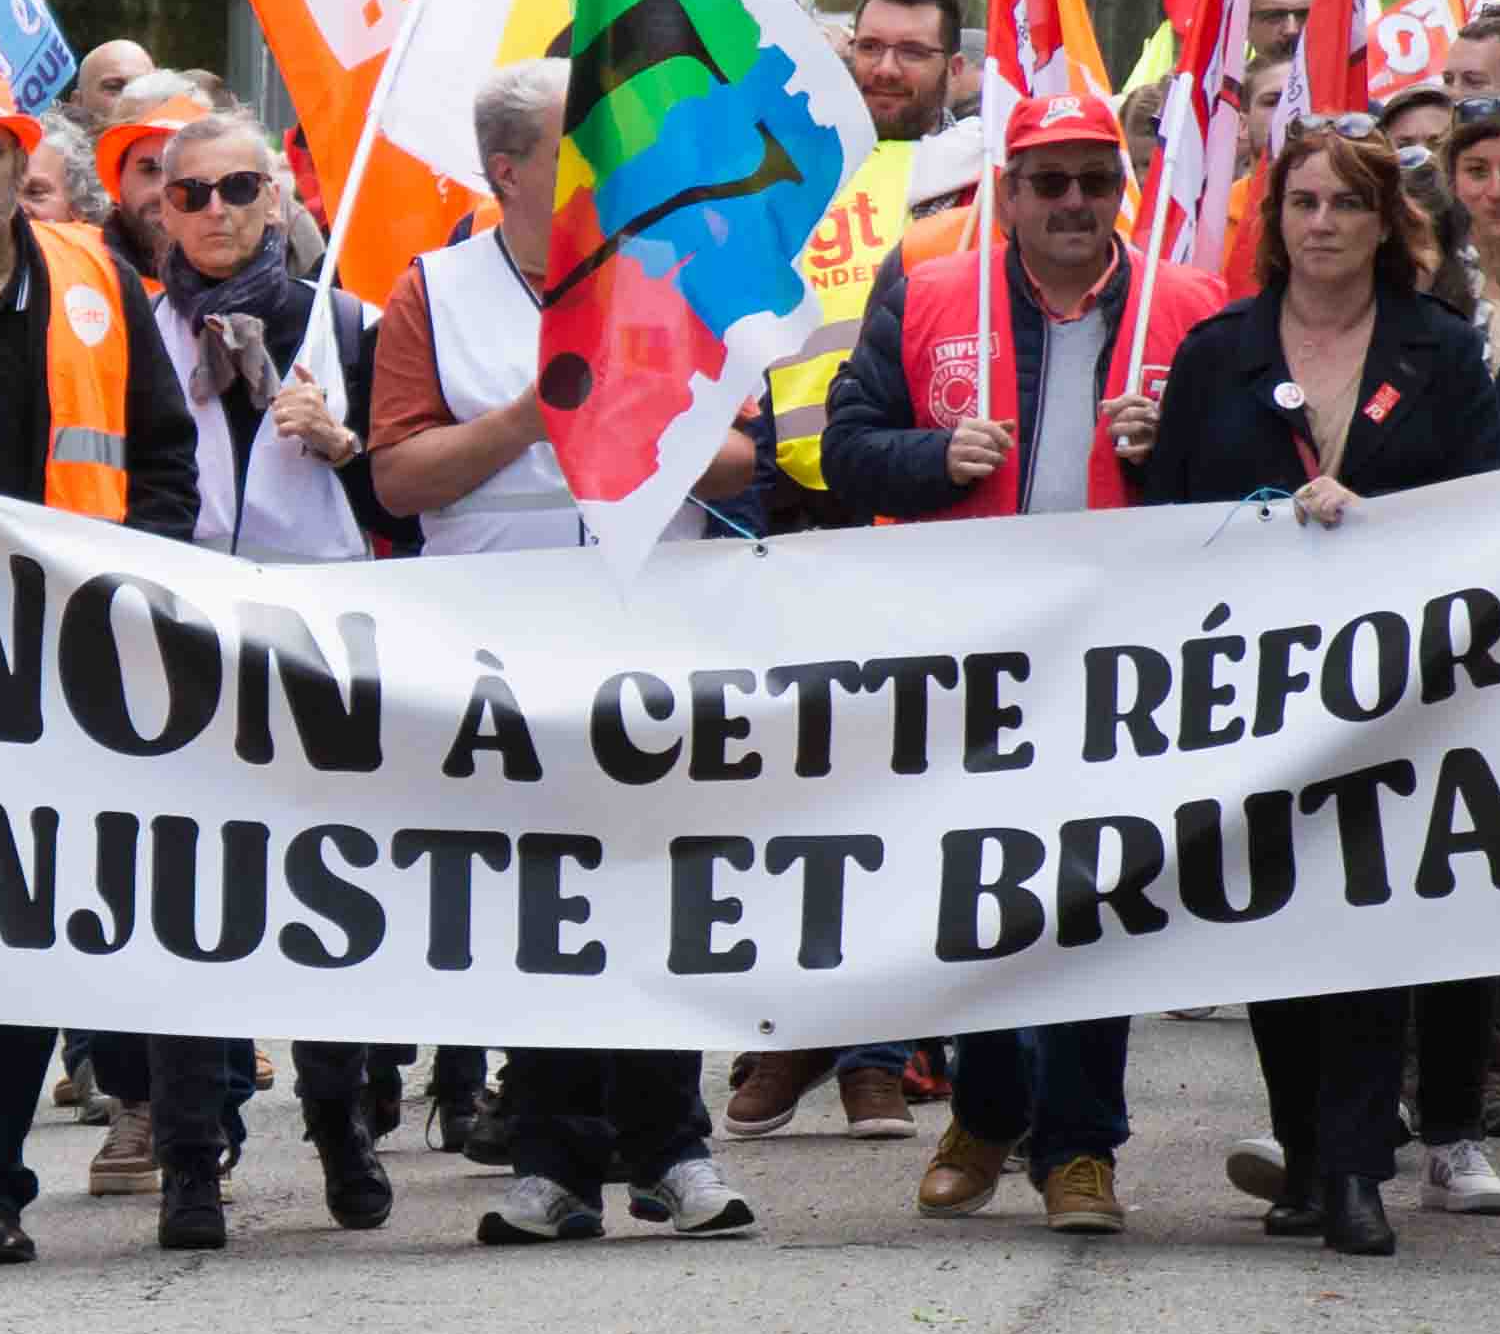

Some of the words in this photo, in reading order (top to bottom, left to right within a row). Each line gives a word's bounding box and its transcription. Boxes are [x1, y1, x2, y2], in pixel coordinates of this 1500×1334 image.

[447, 652, 543, 782] À
[588, 649, 1034, 787] CETTE
[666, 833, 882, 975] ET
